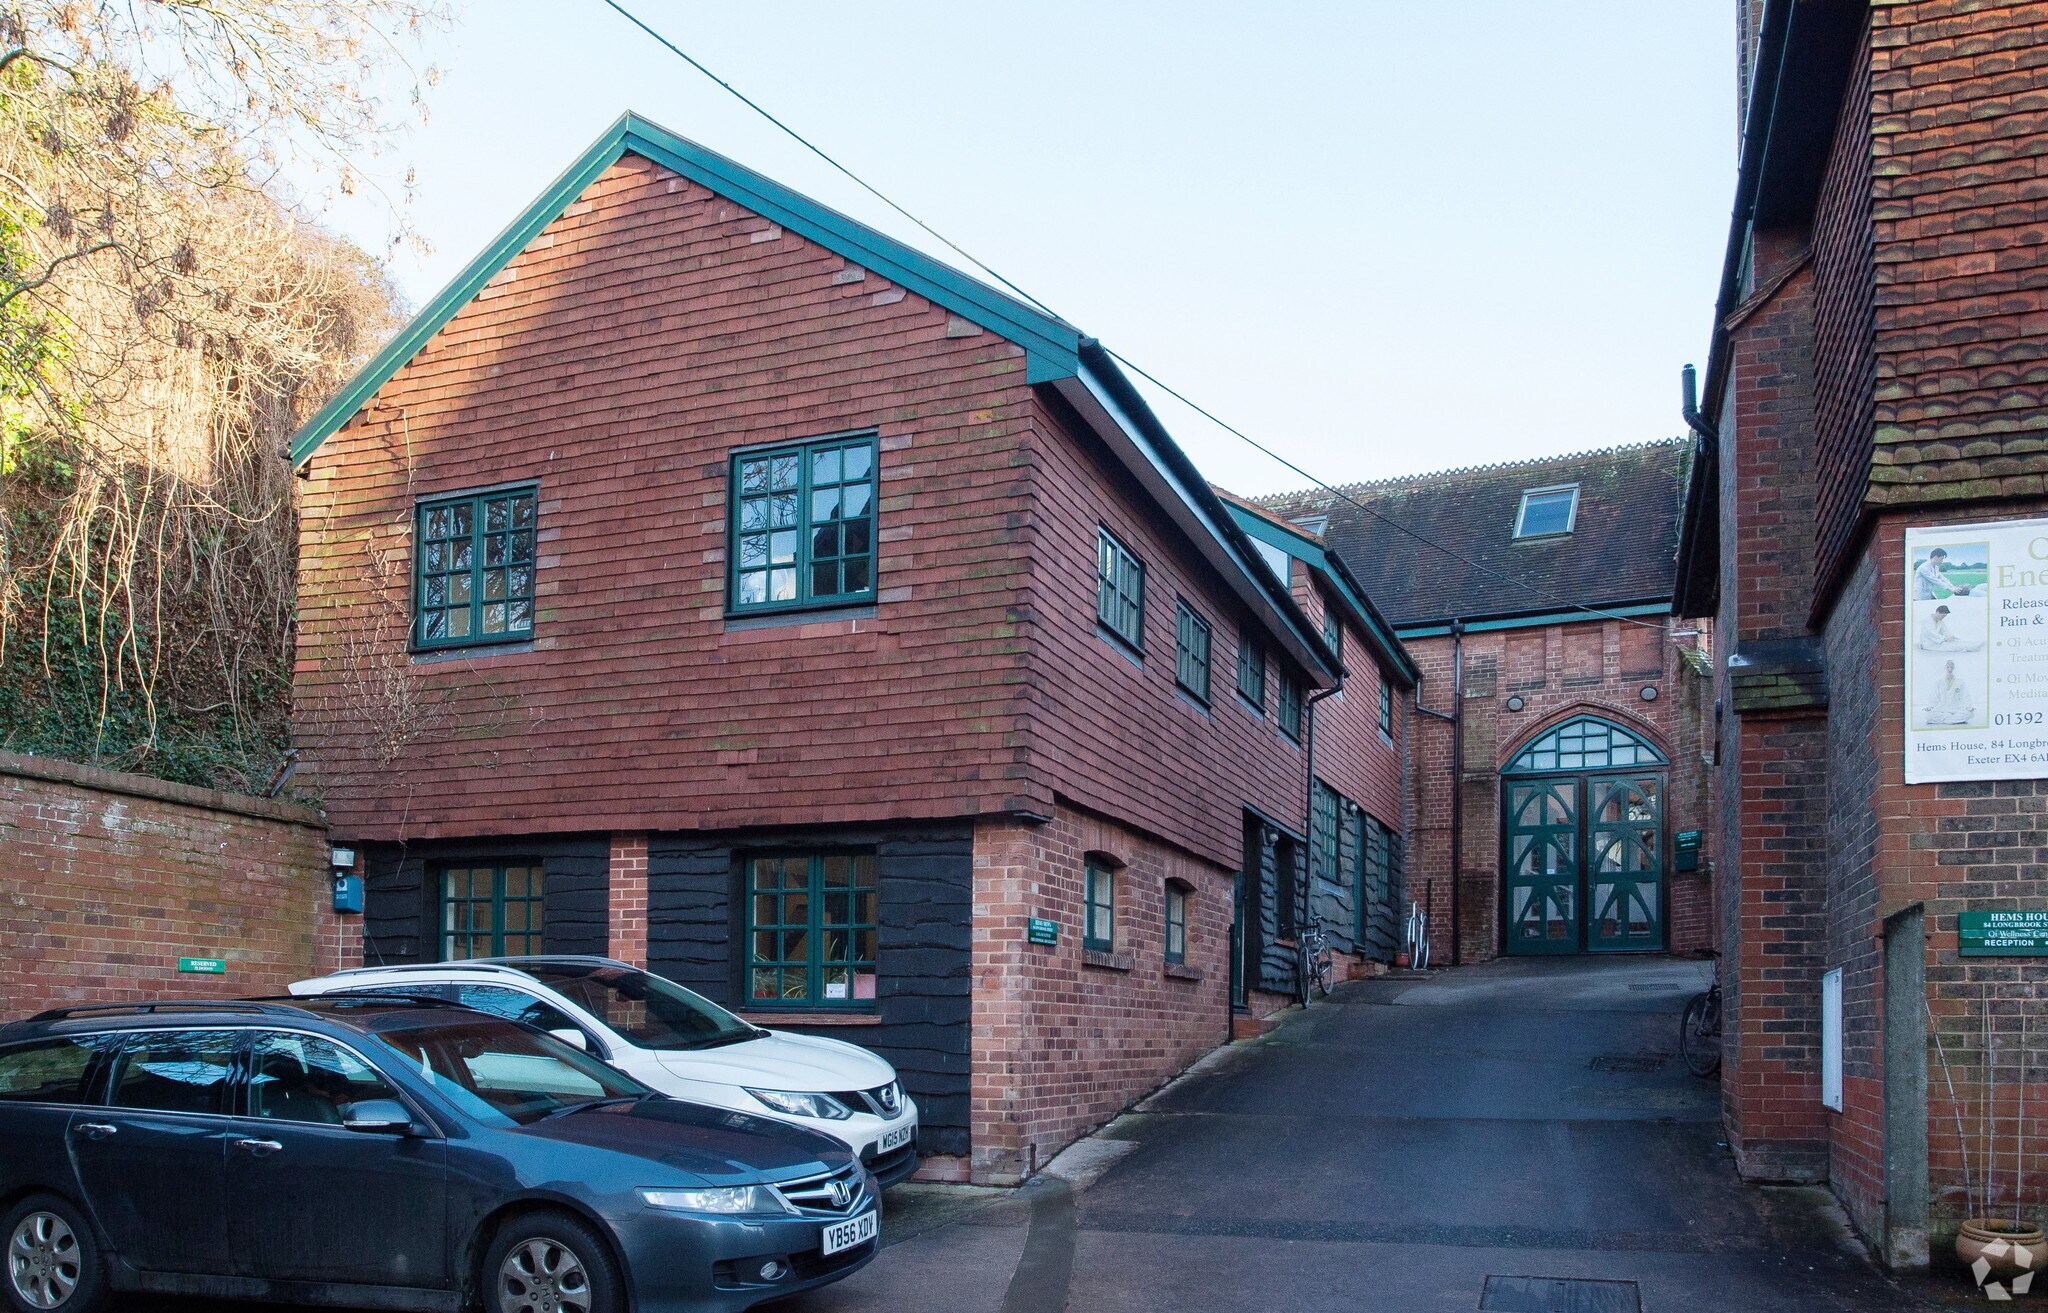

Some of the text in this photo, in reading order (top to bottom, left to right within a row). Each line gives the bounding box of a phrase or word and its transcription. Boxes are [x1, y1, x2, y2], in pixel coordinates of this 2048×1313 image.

[2002, 598, 2048, 610] Release
[2000, 613, 2044, 627] Pain &
[2007, 637, 2020, 648] Qi
[2007, 673, 2020, 684] Qi
[1994, 711, 2043, 726] 01392
[1917, 738, 2048, 752] Hems House, 84 Longbr
[1967, 752, 2048, 765] Exeter EX4 6A
[1991, 913, 2023, 921] HEMS
[1999, 930, 2031, 938] Wellness
[1984, 939, 2034, 947] RECEPTION
[828, 1214, 874, 1250] YB56 XDY
